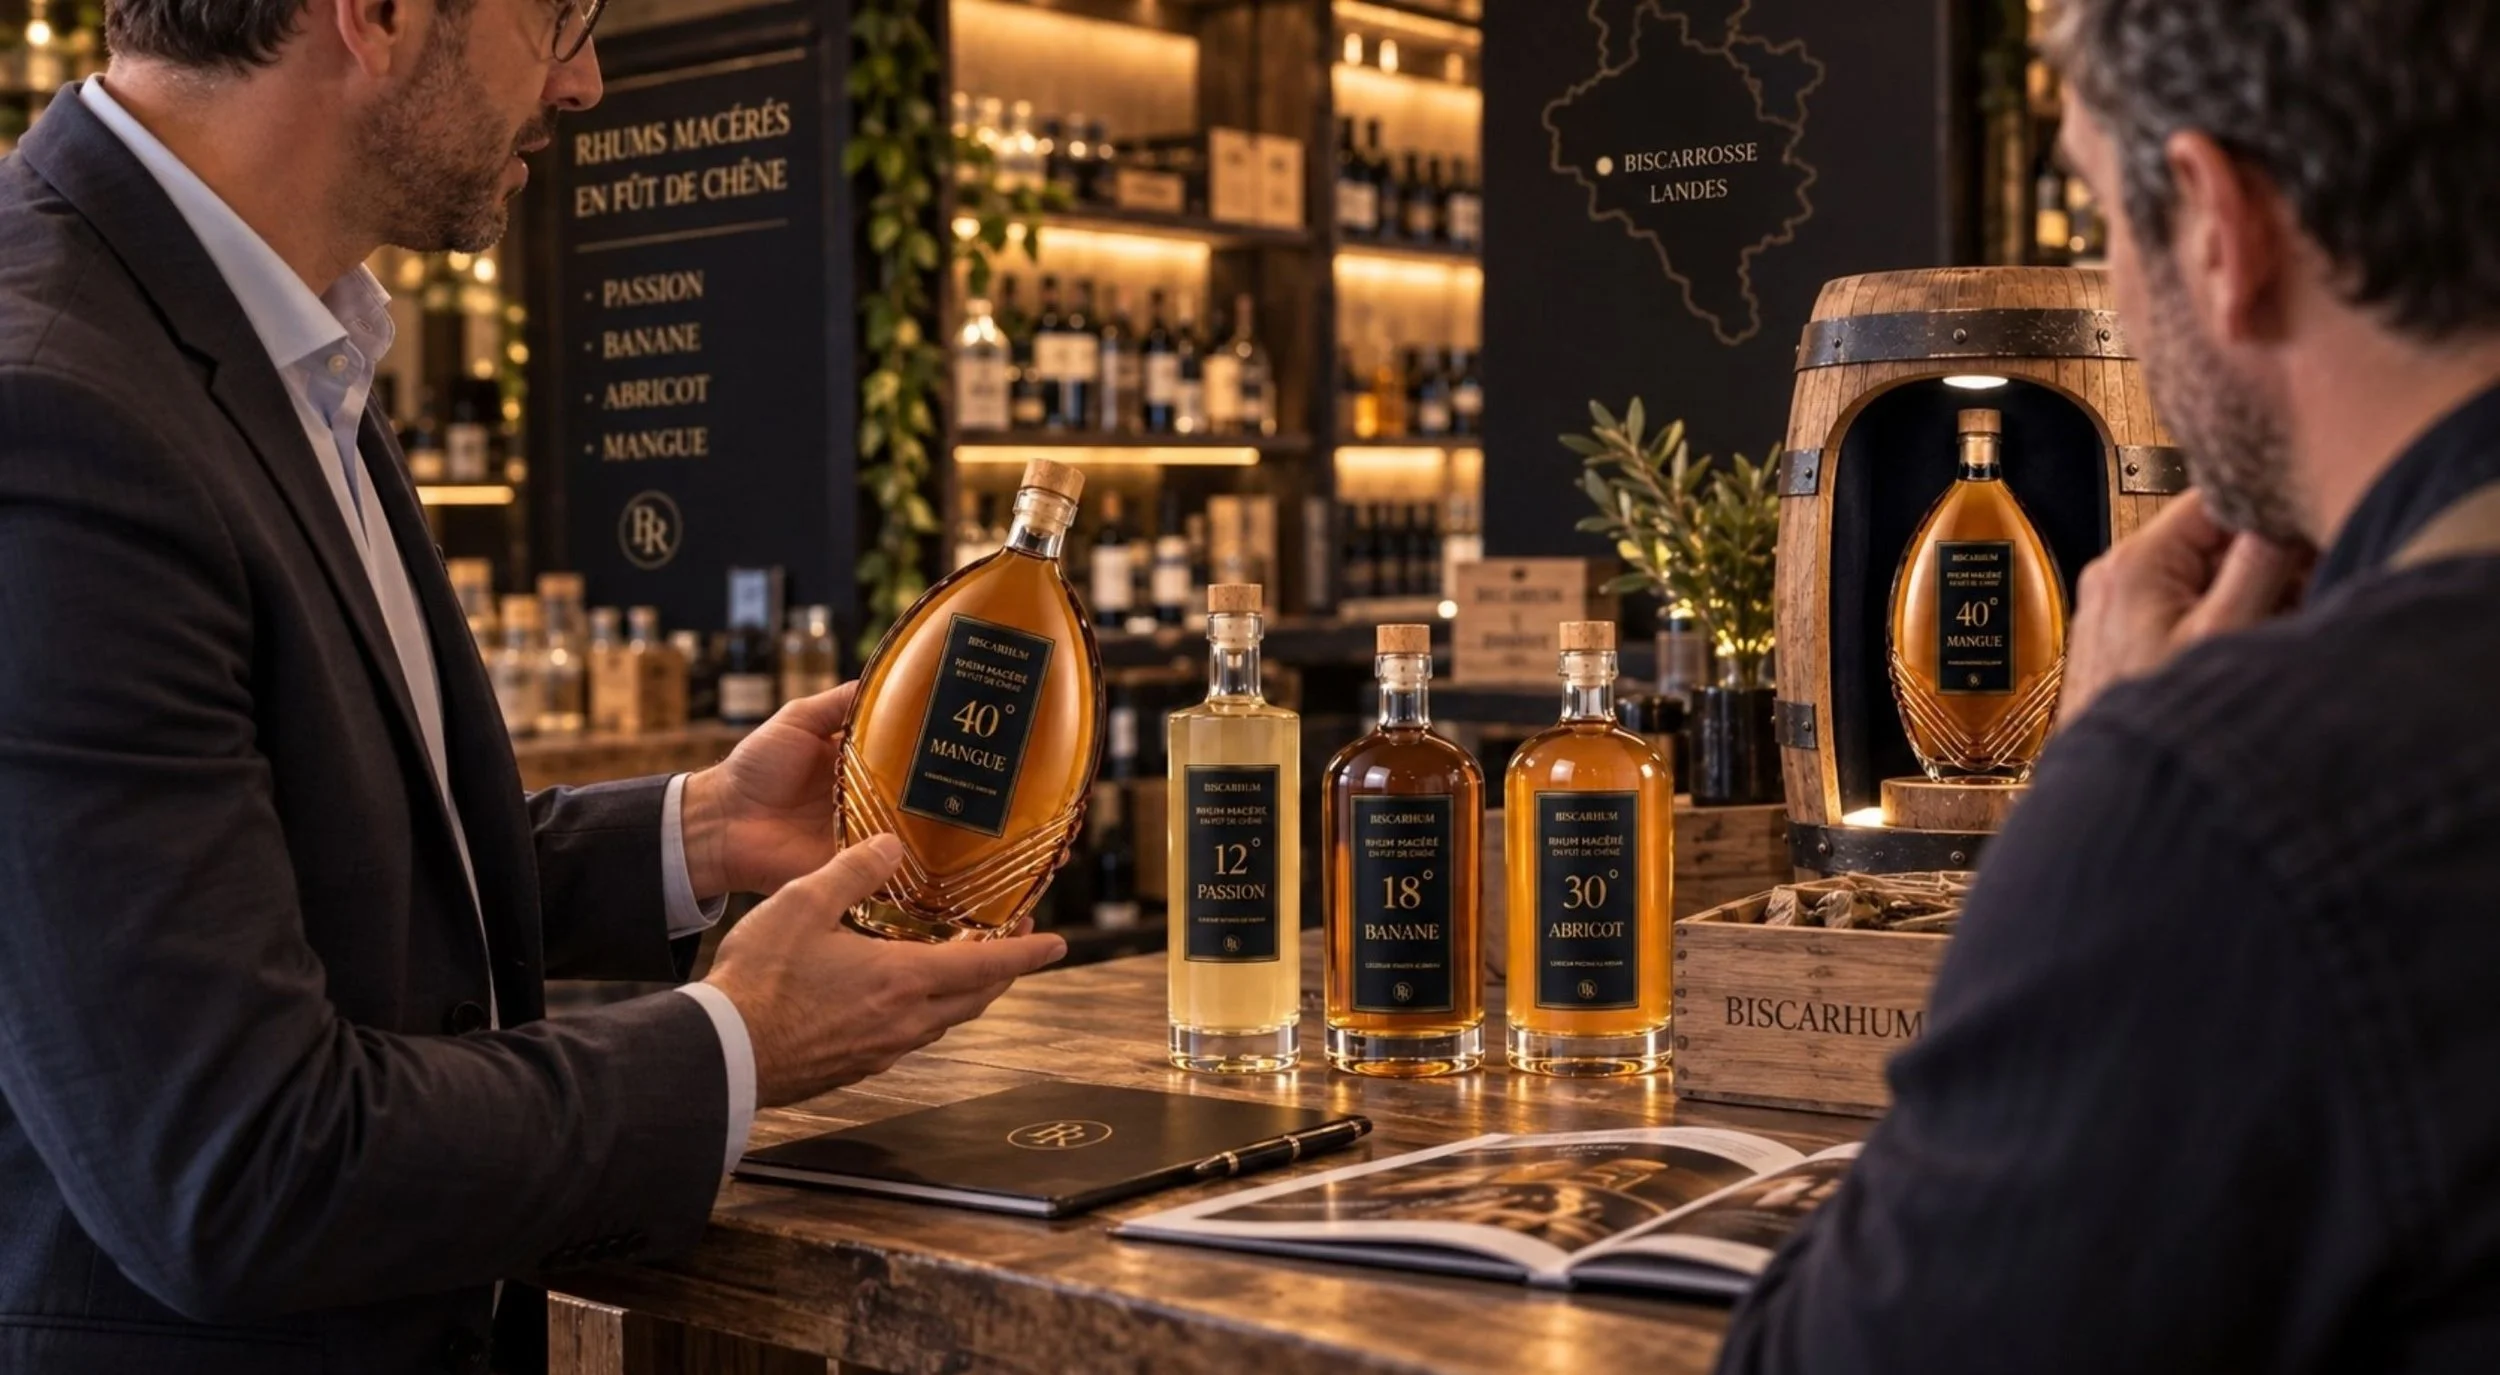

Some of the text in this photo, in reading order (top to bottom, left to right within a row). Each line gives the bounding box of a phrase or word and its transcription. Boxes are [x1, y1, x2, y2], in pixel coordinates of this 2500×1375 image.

[575, 98, 791, 166] RHUMS MACÉRÉS
[1625, 142, 1758, 173] BISCARROSSE
[575, 157, 788, 218] EN FÛT DE CHÊNE
[1651, 179, 1728, 203] LANDES
[603, 270, 704, 308] PASSION
[603, 322, 702, 359] BANANE
[603, 374, 711, 410] ABRICOT
[603, 427, 709, 461] MANGUE
[1956, 597, 1999, 628] 40°
[1947, 634, 2003, 648] MANGUE
[952, 700, 1016, 738] 40°
[930, 738, 1007, 772] MANGUE
[1214, 837, 1262, 876] 12°
[1197, 883, 1267, 900] PASSION
[1383, 868, 1434, 910] 18°
[1563, 868, 1619, 910] 30°
[1364, 923, 1440, 941] BANANE
[1548, 921, 1625, 939] ABRICOT
[1725, 995, 1926, 1041] BISCARHUM
